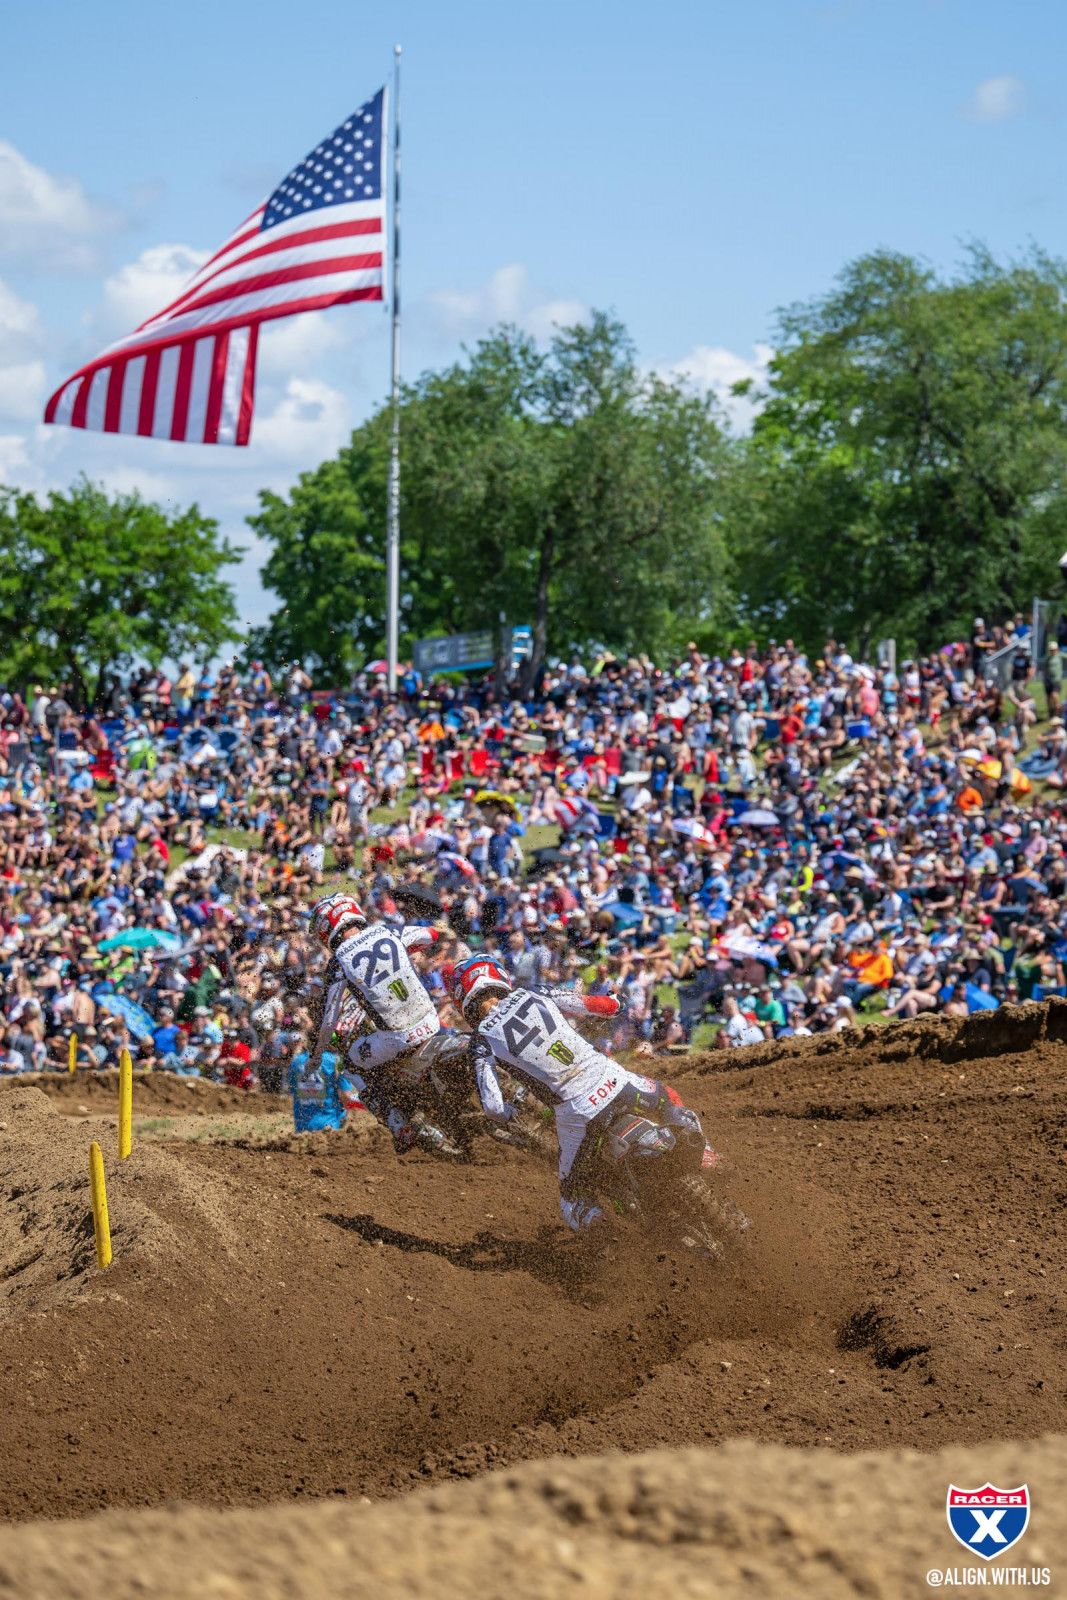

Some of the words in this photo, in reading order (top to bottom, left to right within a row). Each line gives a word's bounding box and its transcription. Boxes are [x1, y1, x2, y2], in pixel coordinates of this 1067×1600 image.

[351, 938, 400, 988] 29
[484, 991, 527, 1032] KITCHEN
[503, 997, 557, 1058] 47
[408, 1024, 432, 1042] FOX
[588, 1079, 616, 1107] FOX
